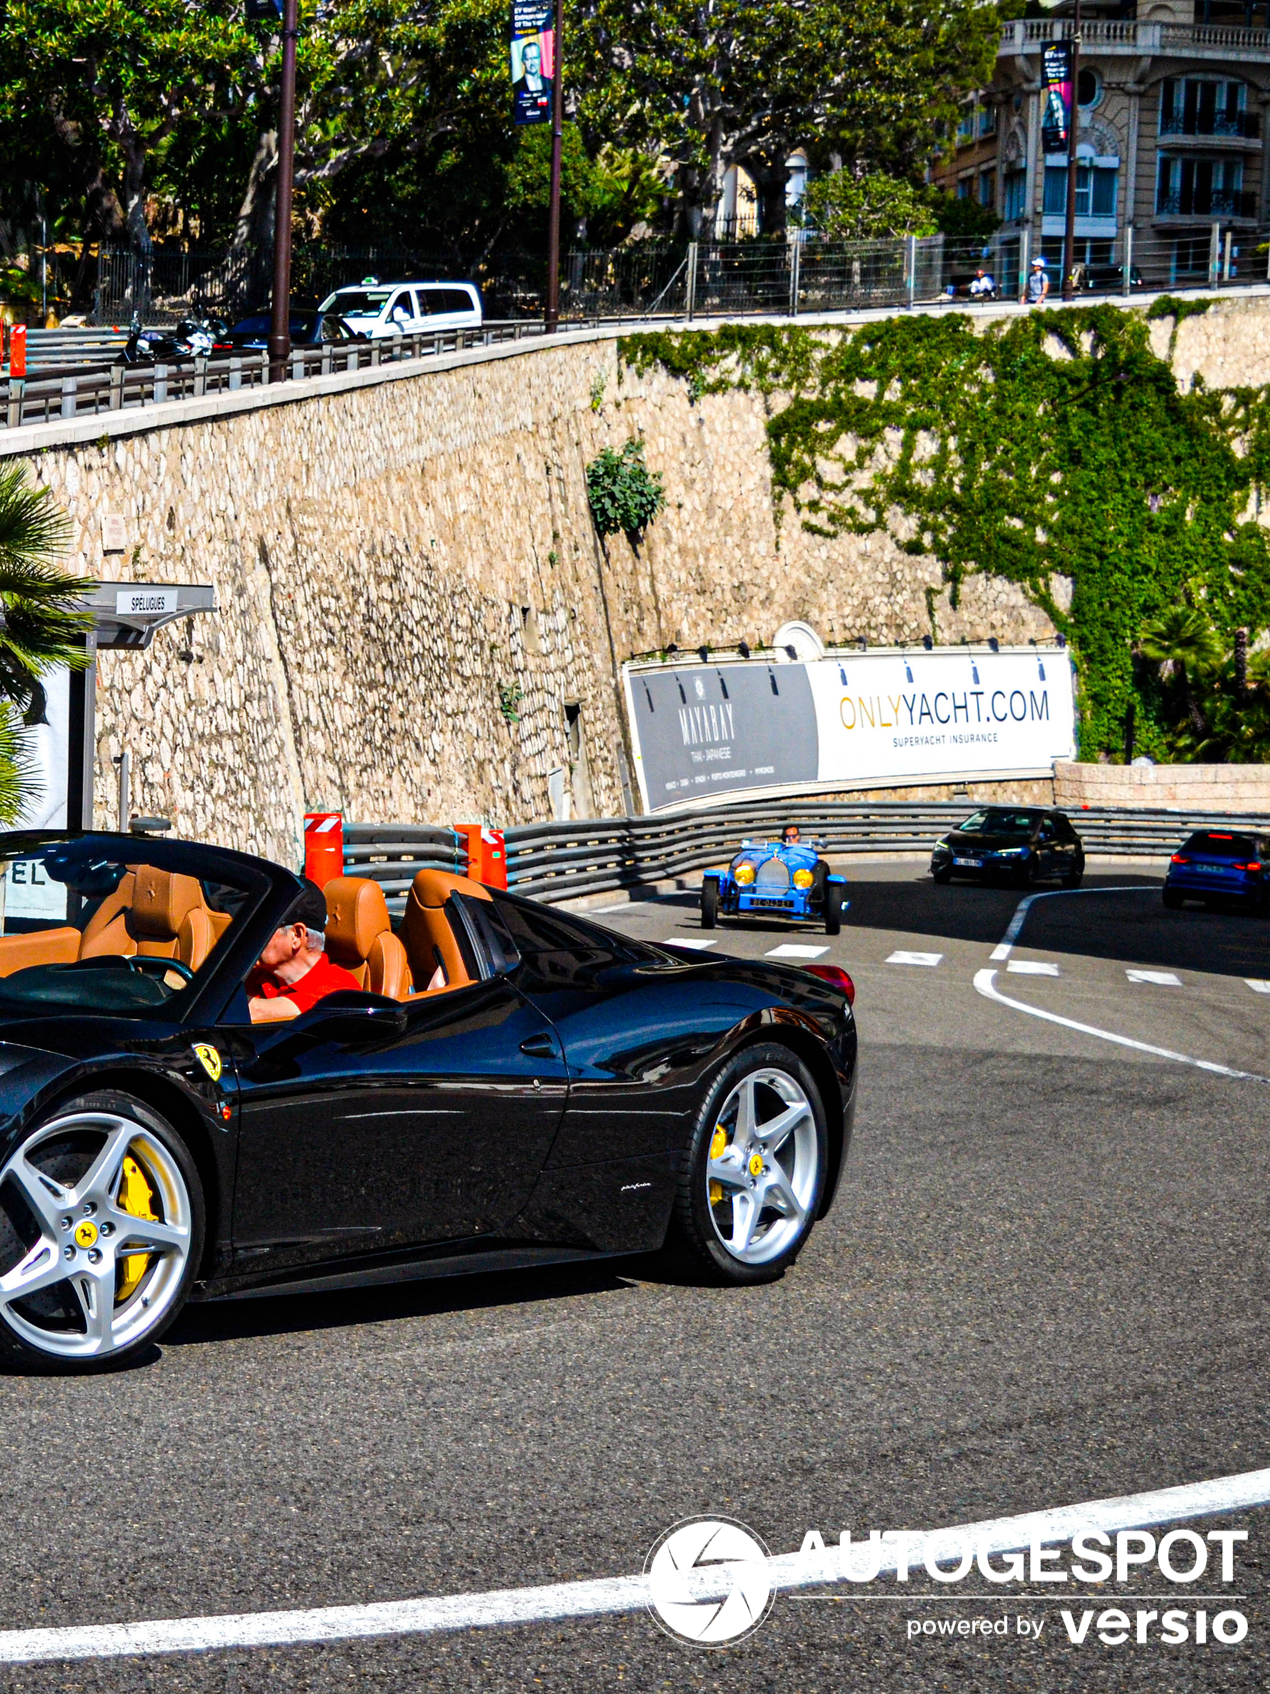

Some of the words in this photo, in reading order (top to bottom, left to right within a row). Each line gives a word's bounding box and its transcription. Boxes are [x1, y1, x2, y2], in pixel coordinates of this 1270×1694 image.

[678, 703, 735, 745] MAYABAY
[839, 690, 1049, 730] ONLYYACHT.COM
[893, 735, 945, 747] SUPERYACHT
[950, 732, 998, 744] INSURANCE
